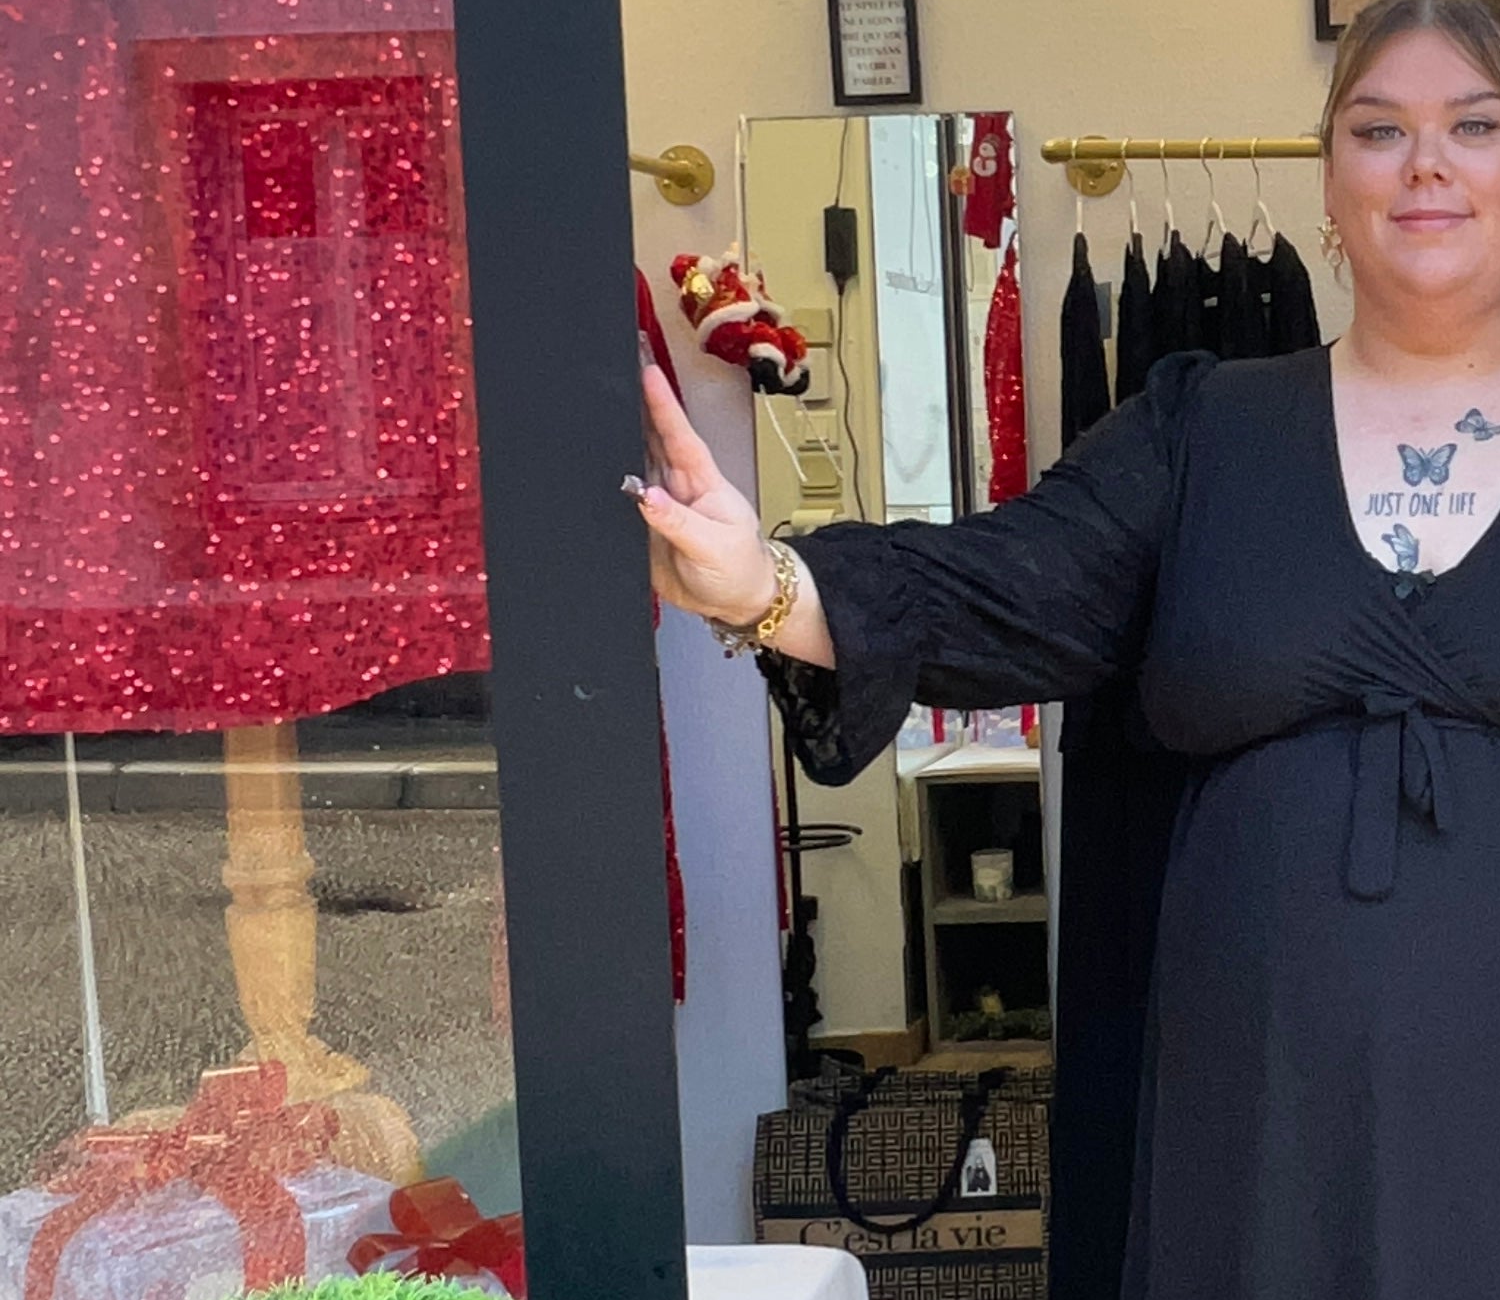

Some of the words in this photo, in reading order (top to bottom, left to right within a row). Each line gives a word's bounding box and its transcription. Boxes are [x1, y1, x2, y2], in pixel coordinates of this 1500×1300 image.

[1364, 492, 1404, 516] JUST
[1409, 492, 1442, 517] ONE
[1448, 492, 1477, 516] LIFE
[911, 1226, 940, 1250] la
[950, 1215, 1006, 1247] vie
